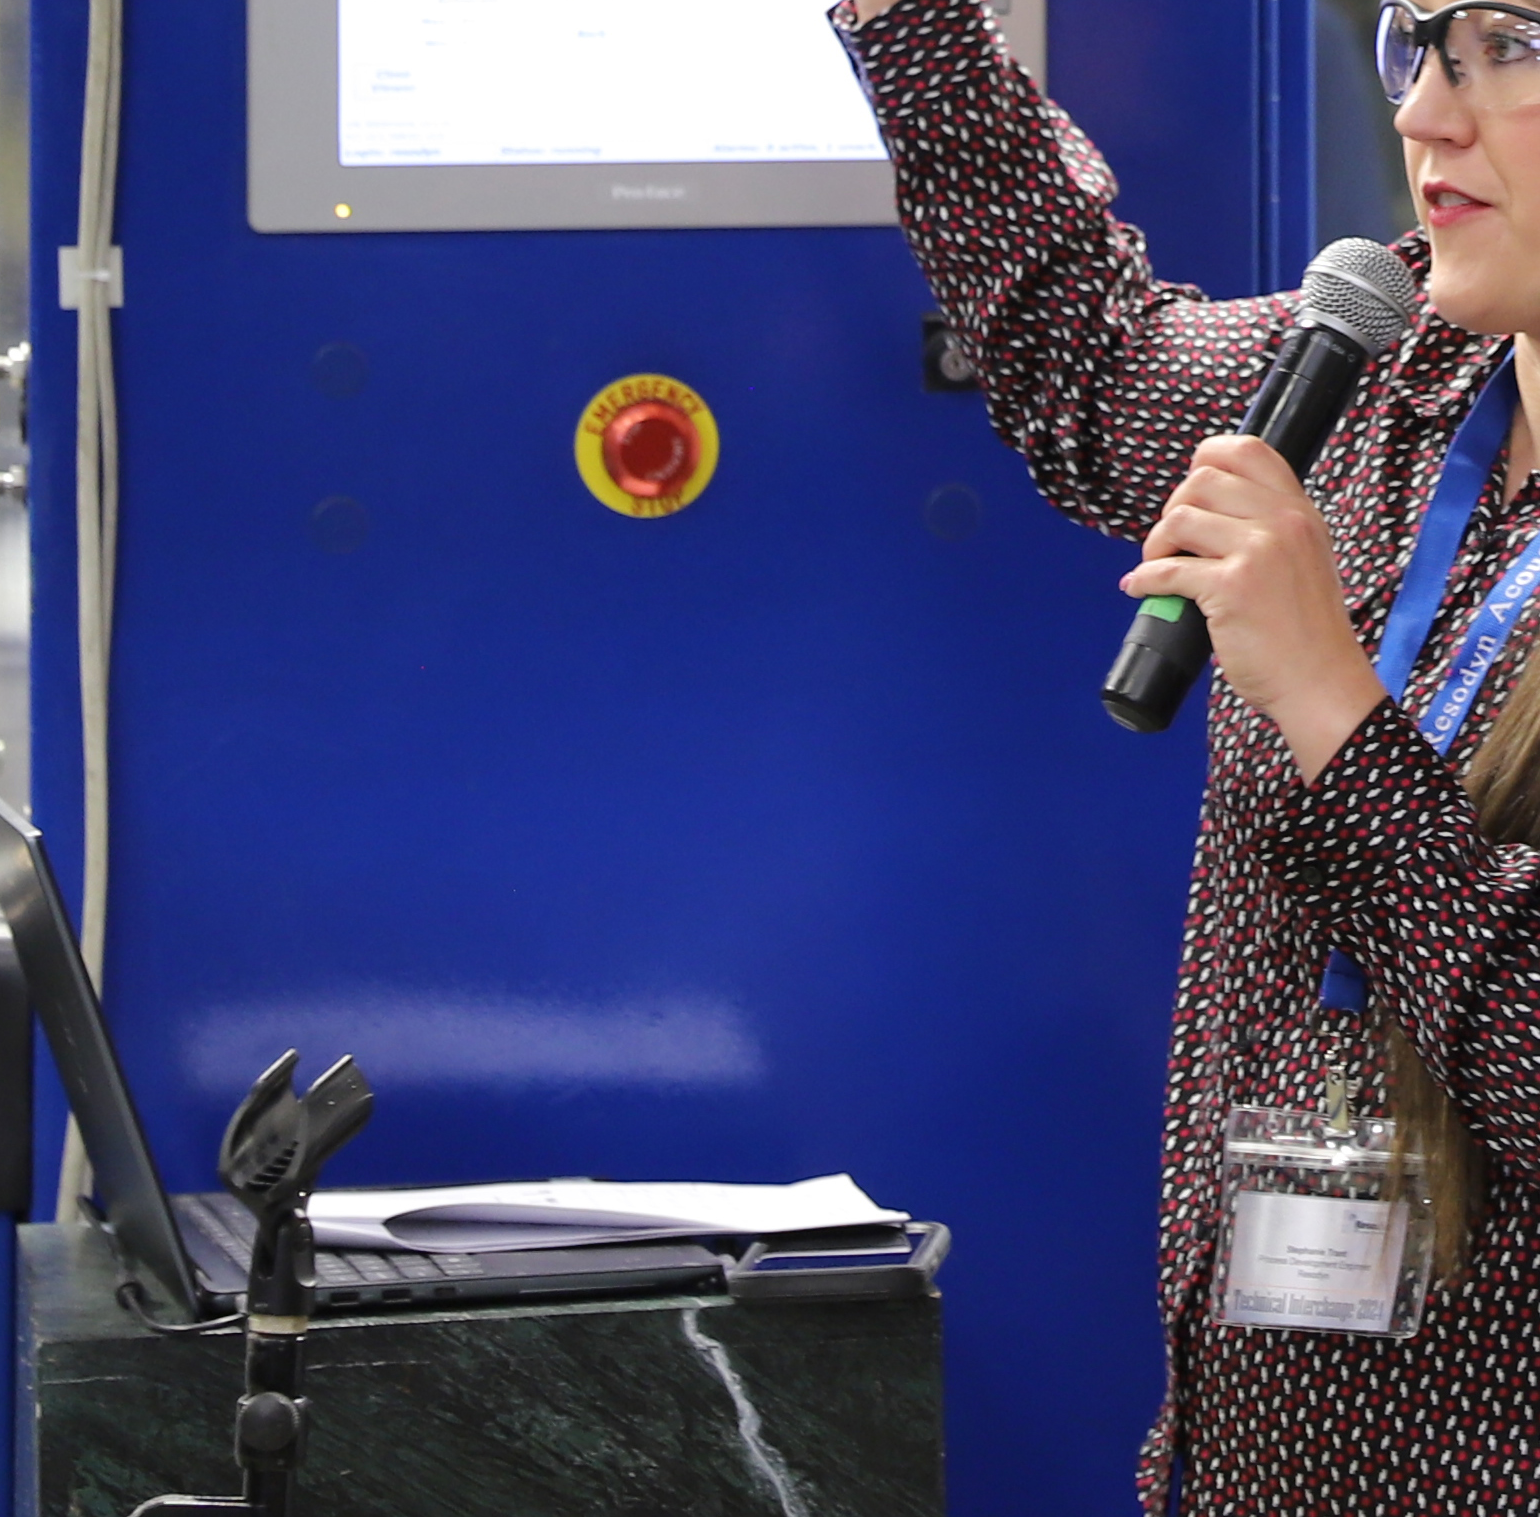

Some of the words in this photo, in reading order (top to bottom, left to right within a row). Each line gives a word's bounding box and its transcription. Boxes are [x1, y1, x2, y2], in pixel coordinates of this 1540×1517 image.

[585, 379, 703, 435] EMERGENCY
[1422, 634, 1497, 751] Resodyn
[1234, 1289, 1287, 1314] Technical
[1288, 1291, 1355, 1322] Interchange
